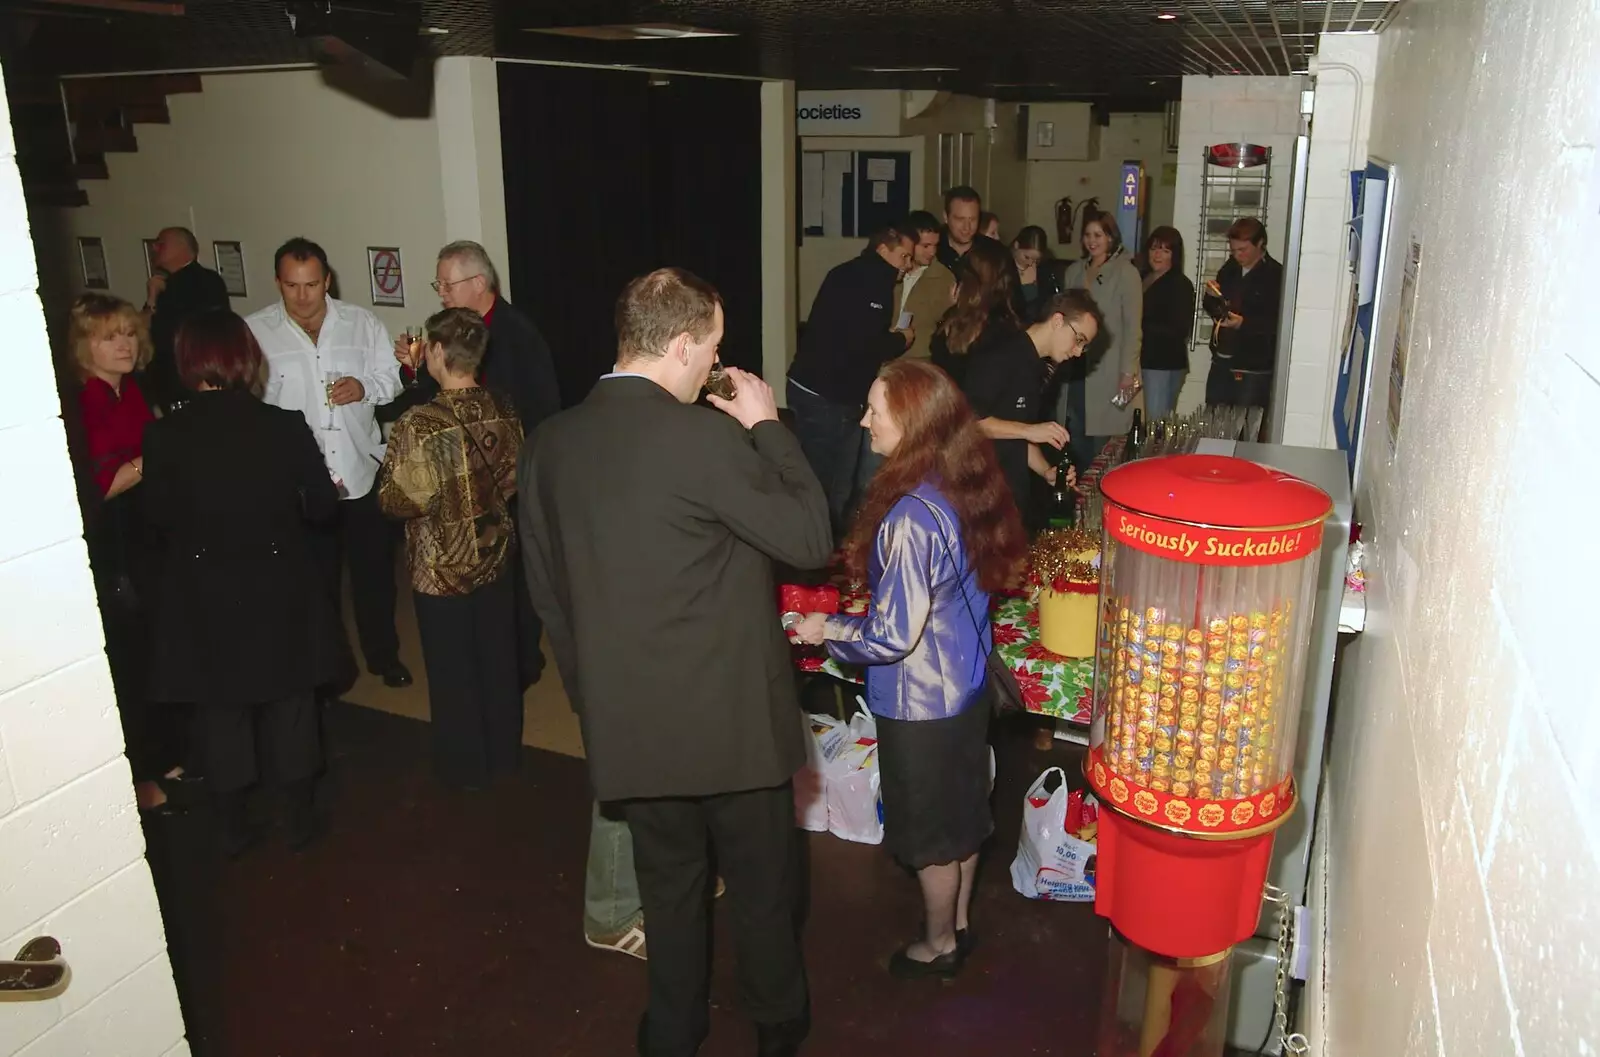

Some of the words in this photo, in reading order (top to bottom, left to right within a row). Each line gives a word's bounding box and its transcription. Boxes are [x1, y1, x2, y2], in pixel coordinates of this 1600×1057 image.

[1123, 172, 1137, 206] ATM
[1118, 516, 1200, 558] Seriously
[1203, 532, 1302, 558] Suckable!
[1040, 877, 1073, 891] Helping
